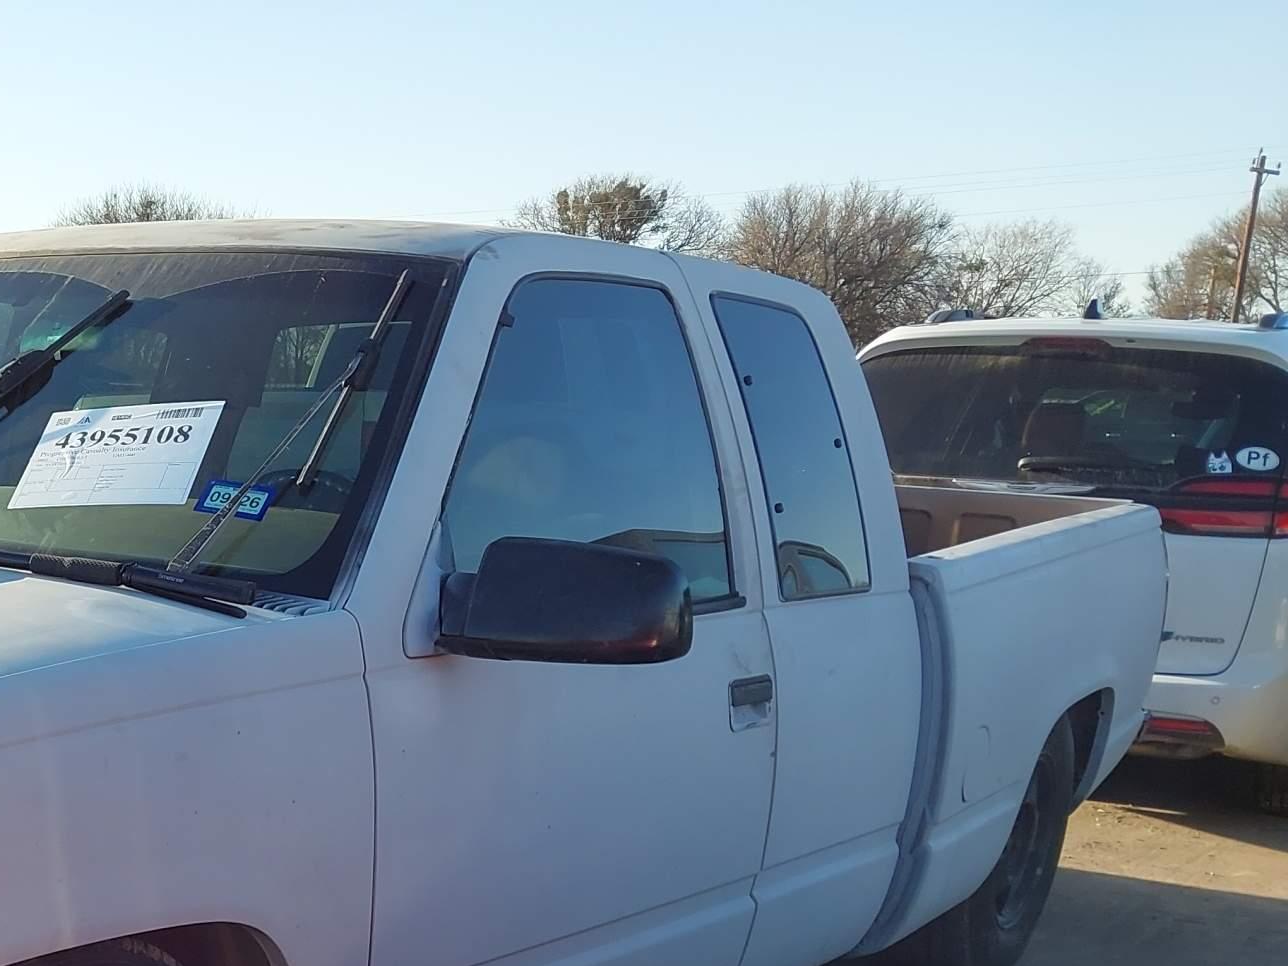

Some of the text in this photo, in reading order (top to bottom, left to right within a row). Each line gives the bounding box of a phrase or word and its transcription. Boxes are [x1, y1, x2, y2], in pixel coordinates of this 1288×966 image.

[55, 424, 193, 449] 43955108
[40, 449, 80, 458] Progreive
[112, 445, 147, 453] Insurance
[1247, 450, 1271, 467] Pf
[209, 491, 261, 508] 09 26
